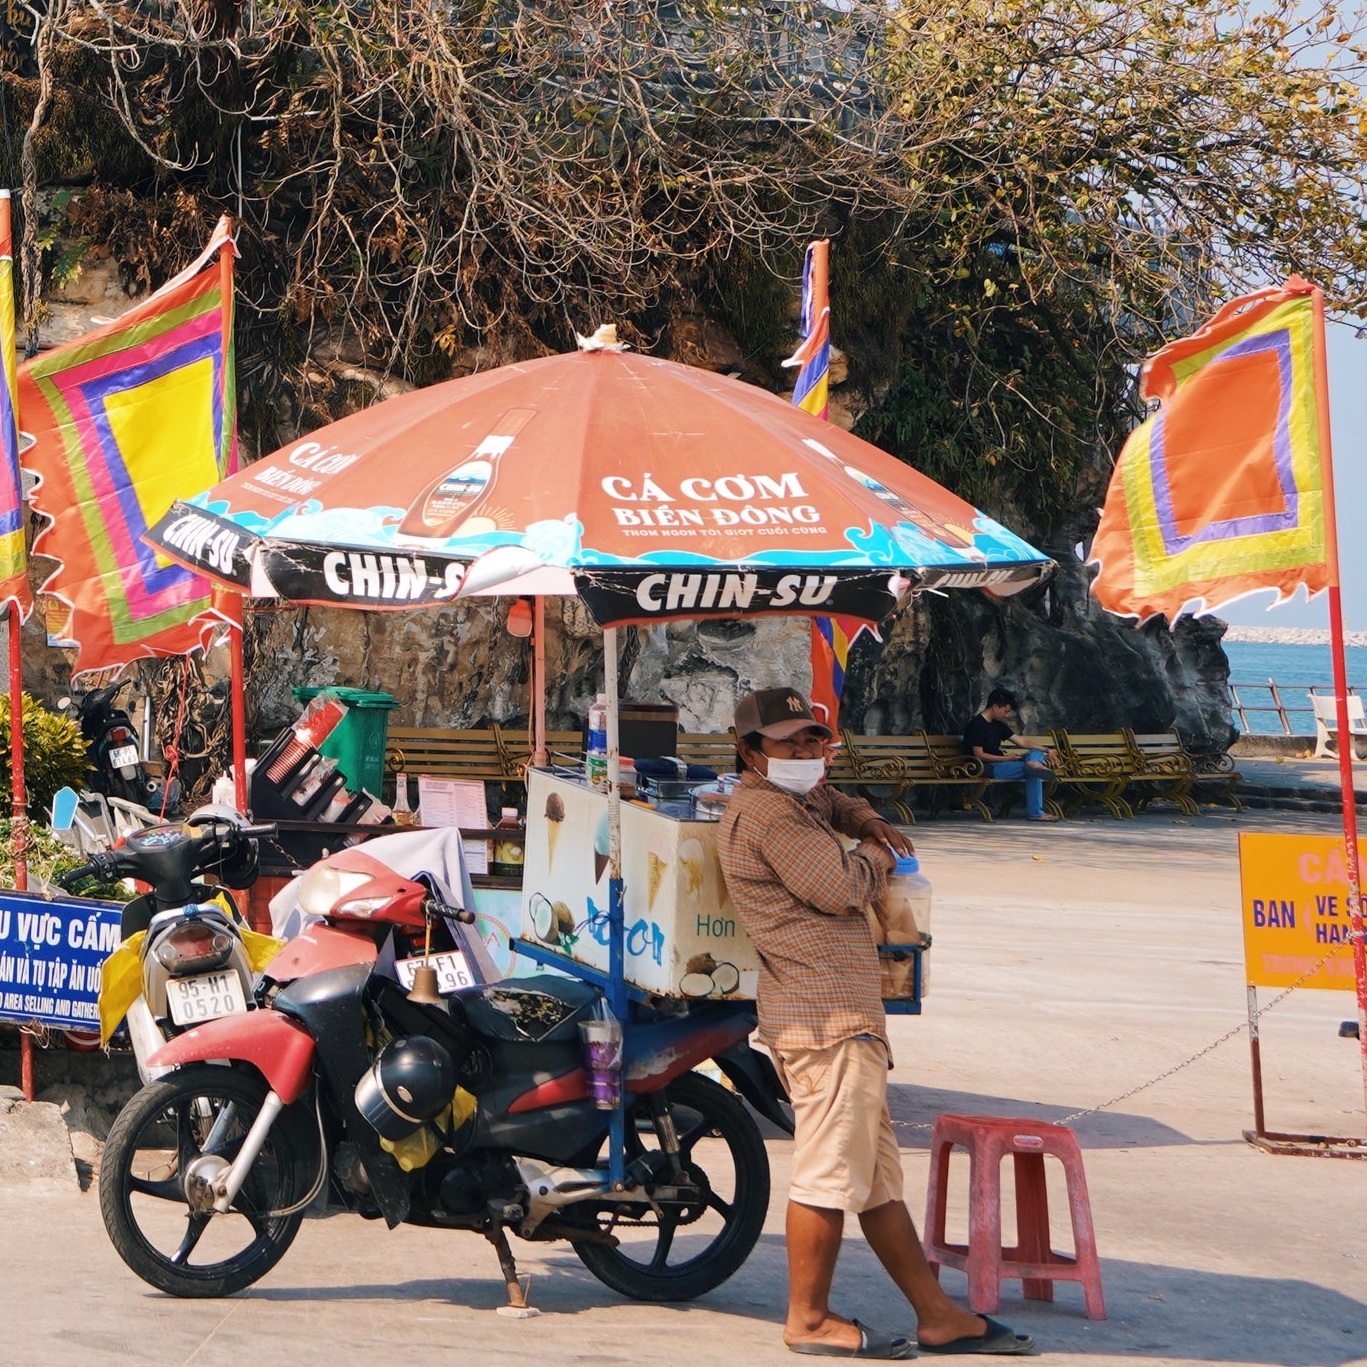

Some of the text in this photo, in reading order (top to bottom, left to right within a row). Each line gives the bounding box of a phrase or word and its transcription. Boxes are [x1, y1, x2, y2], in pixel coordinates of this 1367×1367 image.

[601, 472, 809, 503] CÁ CƠM
[710, 504, 821, 527] ĐÔNG
[162, 513, 241, 575] CHIN-SU
[323, 551, 468, 601] CHIN-S
[636, 572, 839, 613] CHIN-SU
[17, 912, 62, 951] VỰC
[68, 911, 122, 954] CẤM
[696, 914, 736, 938] Hơn
[16, 953, 30, 985] VÀ
[32, 959, 46, 992] TỤ
[48, 957, 68, 994] TẬP
[69, 959, 86, 992] ĂN
[86, 958, 104, 994] UỐ
[178, 974, 230, 1000] 95-H1
[3, 992, 23, 1011] AREA
[24, 995, 55, 1014] SELLING
[55, 999, 71, 1016] AND
[71, 1000, 100, 1020] GATHER
[183, 994, 235, 1020] 0520
